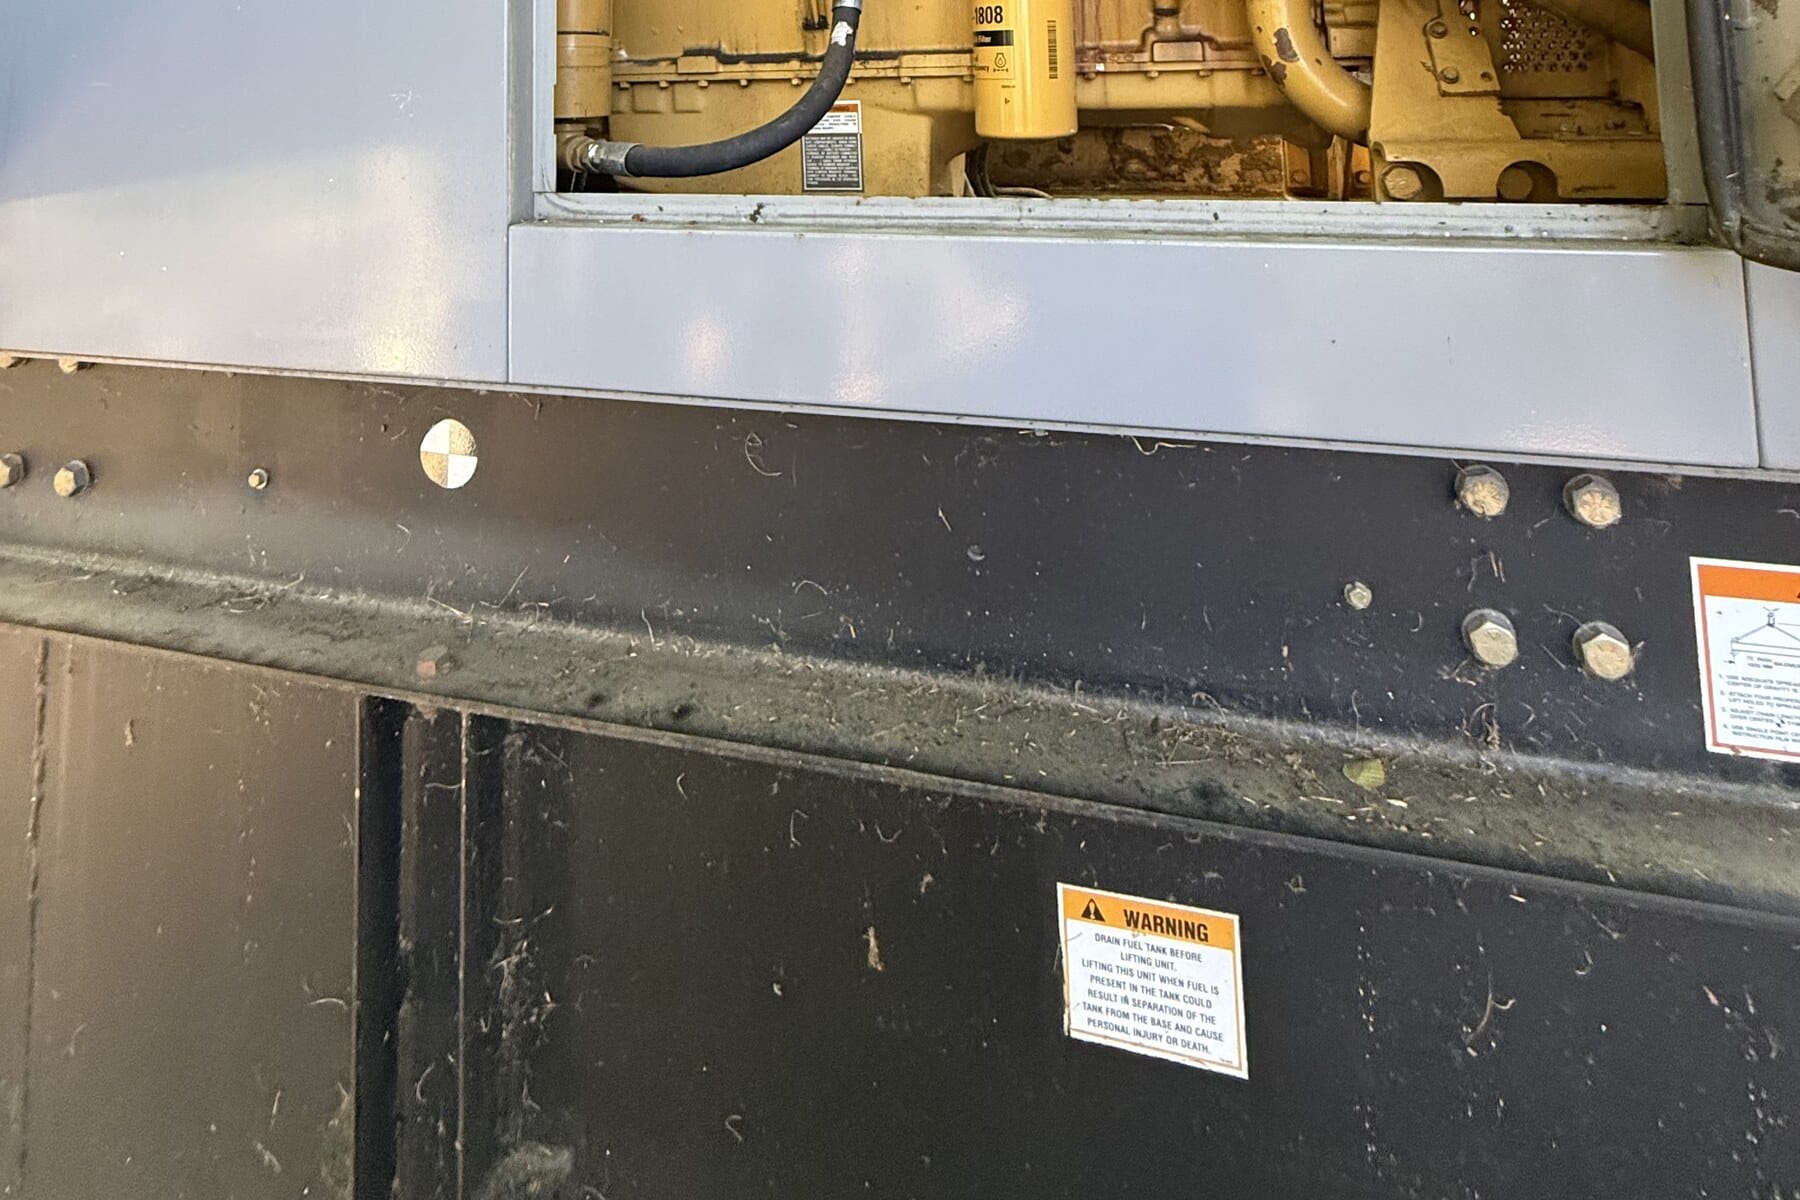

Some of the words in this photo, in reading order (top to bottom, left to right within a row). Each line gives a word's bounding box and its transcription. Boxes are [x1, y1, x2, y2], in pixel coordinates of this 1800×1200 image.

[1123, 909, 1208, 943] WARNING
[1095, 933, 1120, 946] DRAIN
[1123, 938, 1143, 950] FUEL
[1147, 943, 1168, 954] TANK
[1170, 949, 1202, 962] BEFORE
[1121, 953, 1152, 966] LIFTING
[1082, 958, 1113, 973] LIFTING
[1115, 965, 1134, 977] THIS
[1137, 970, 1156, 981] UNIT
[1159, 974, 1184, 988] WHEN
[1187, 980, 1208, 993] FUEL
[1211, 986, 1219, 995] IS
[1090, 975, 1126, 990] PRESENT
[1129, 983, 1138, 992] IN
[1141, 985, 1156, 996] THE
[1159, 989, 1180, 1001] TANK
[1183, 995, 1212, 1009] COULD
[1083, 1002, 1102, 1014] TANK
[1106, 1008, 1129, 1020] FROM
[1133, 1013, 1148, 1024] THE
[1151, 1017, 1172, 1029] BASE
[1174, 1023, 1192, 1034] AND
[1195, 1027, 1223, 1042] CAUSE
[1088, 989, 1117, 1002] RESULT
[1121, 995, 1129, 1004] IN
[1132, 998, 1183, 1017] SEPARATION
[1186, 1010, 1197, 1019] OF
[1199, 1013, 1216, 1025] THE
[1087, 1018, 1130, 1036] PERSONAL
[1133, 1028, 1163, 1042] INJURY
[1166, 1036, 1178, 1045] OR
